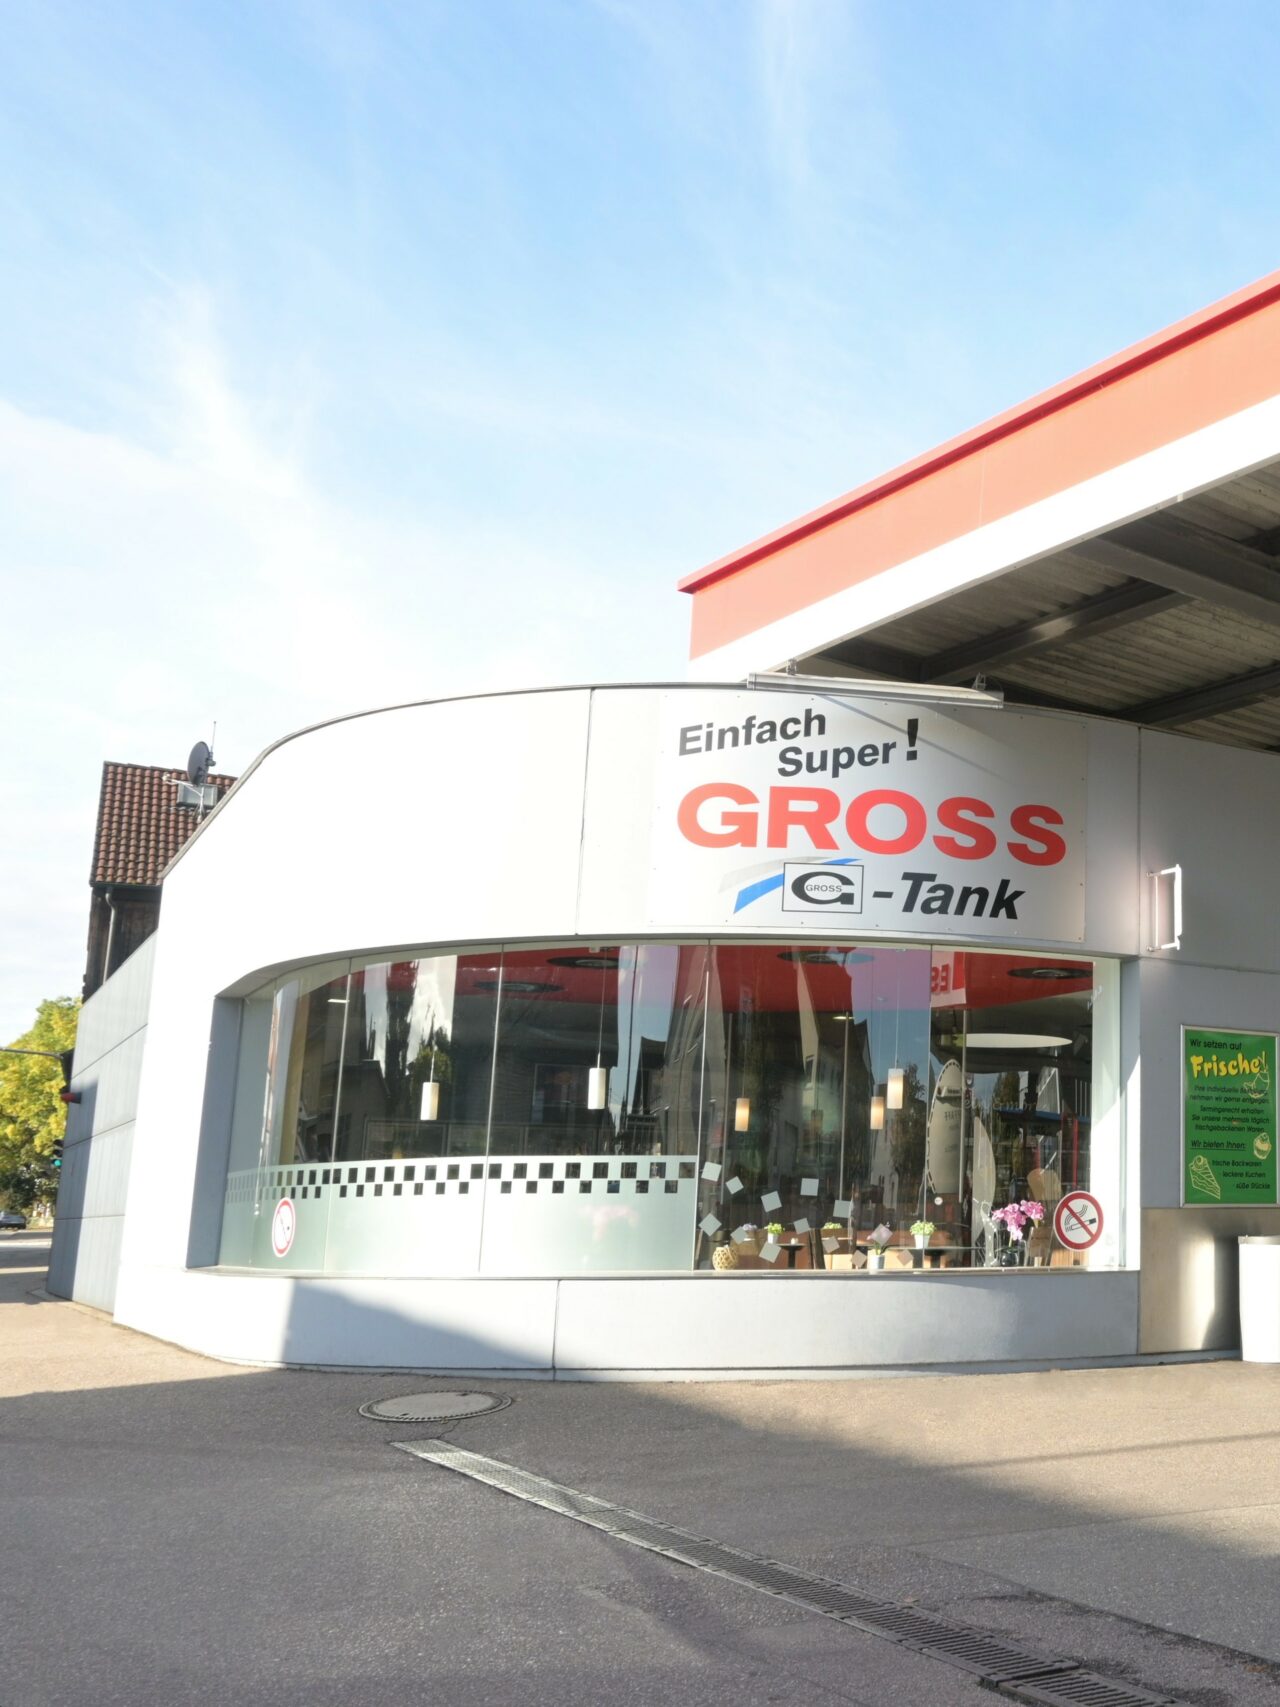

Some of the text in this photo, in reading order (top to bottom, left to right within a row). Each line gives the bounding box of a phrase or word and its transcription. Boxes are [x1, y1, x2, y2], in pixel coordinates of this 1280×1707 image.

[678, 707, 827, 756] Einfach
[777, 718, 919, 778] Super!
[676, 782, 1067, 867] GROSS
[805, 883, 842, 893] GROSS
[1190, 1038, 1243, 1050] Wir setzen auf
